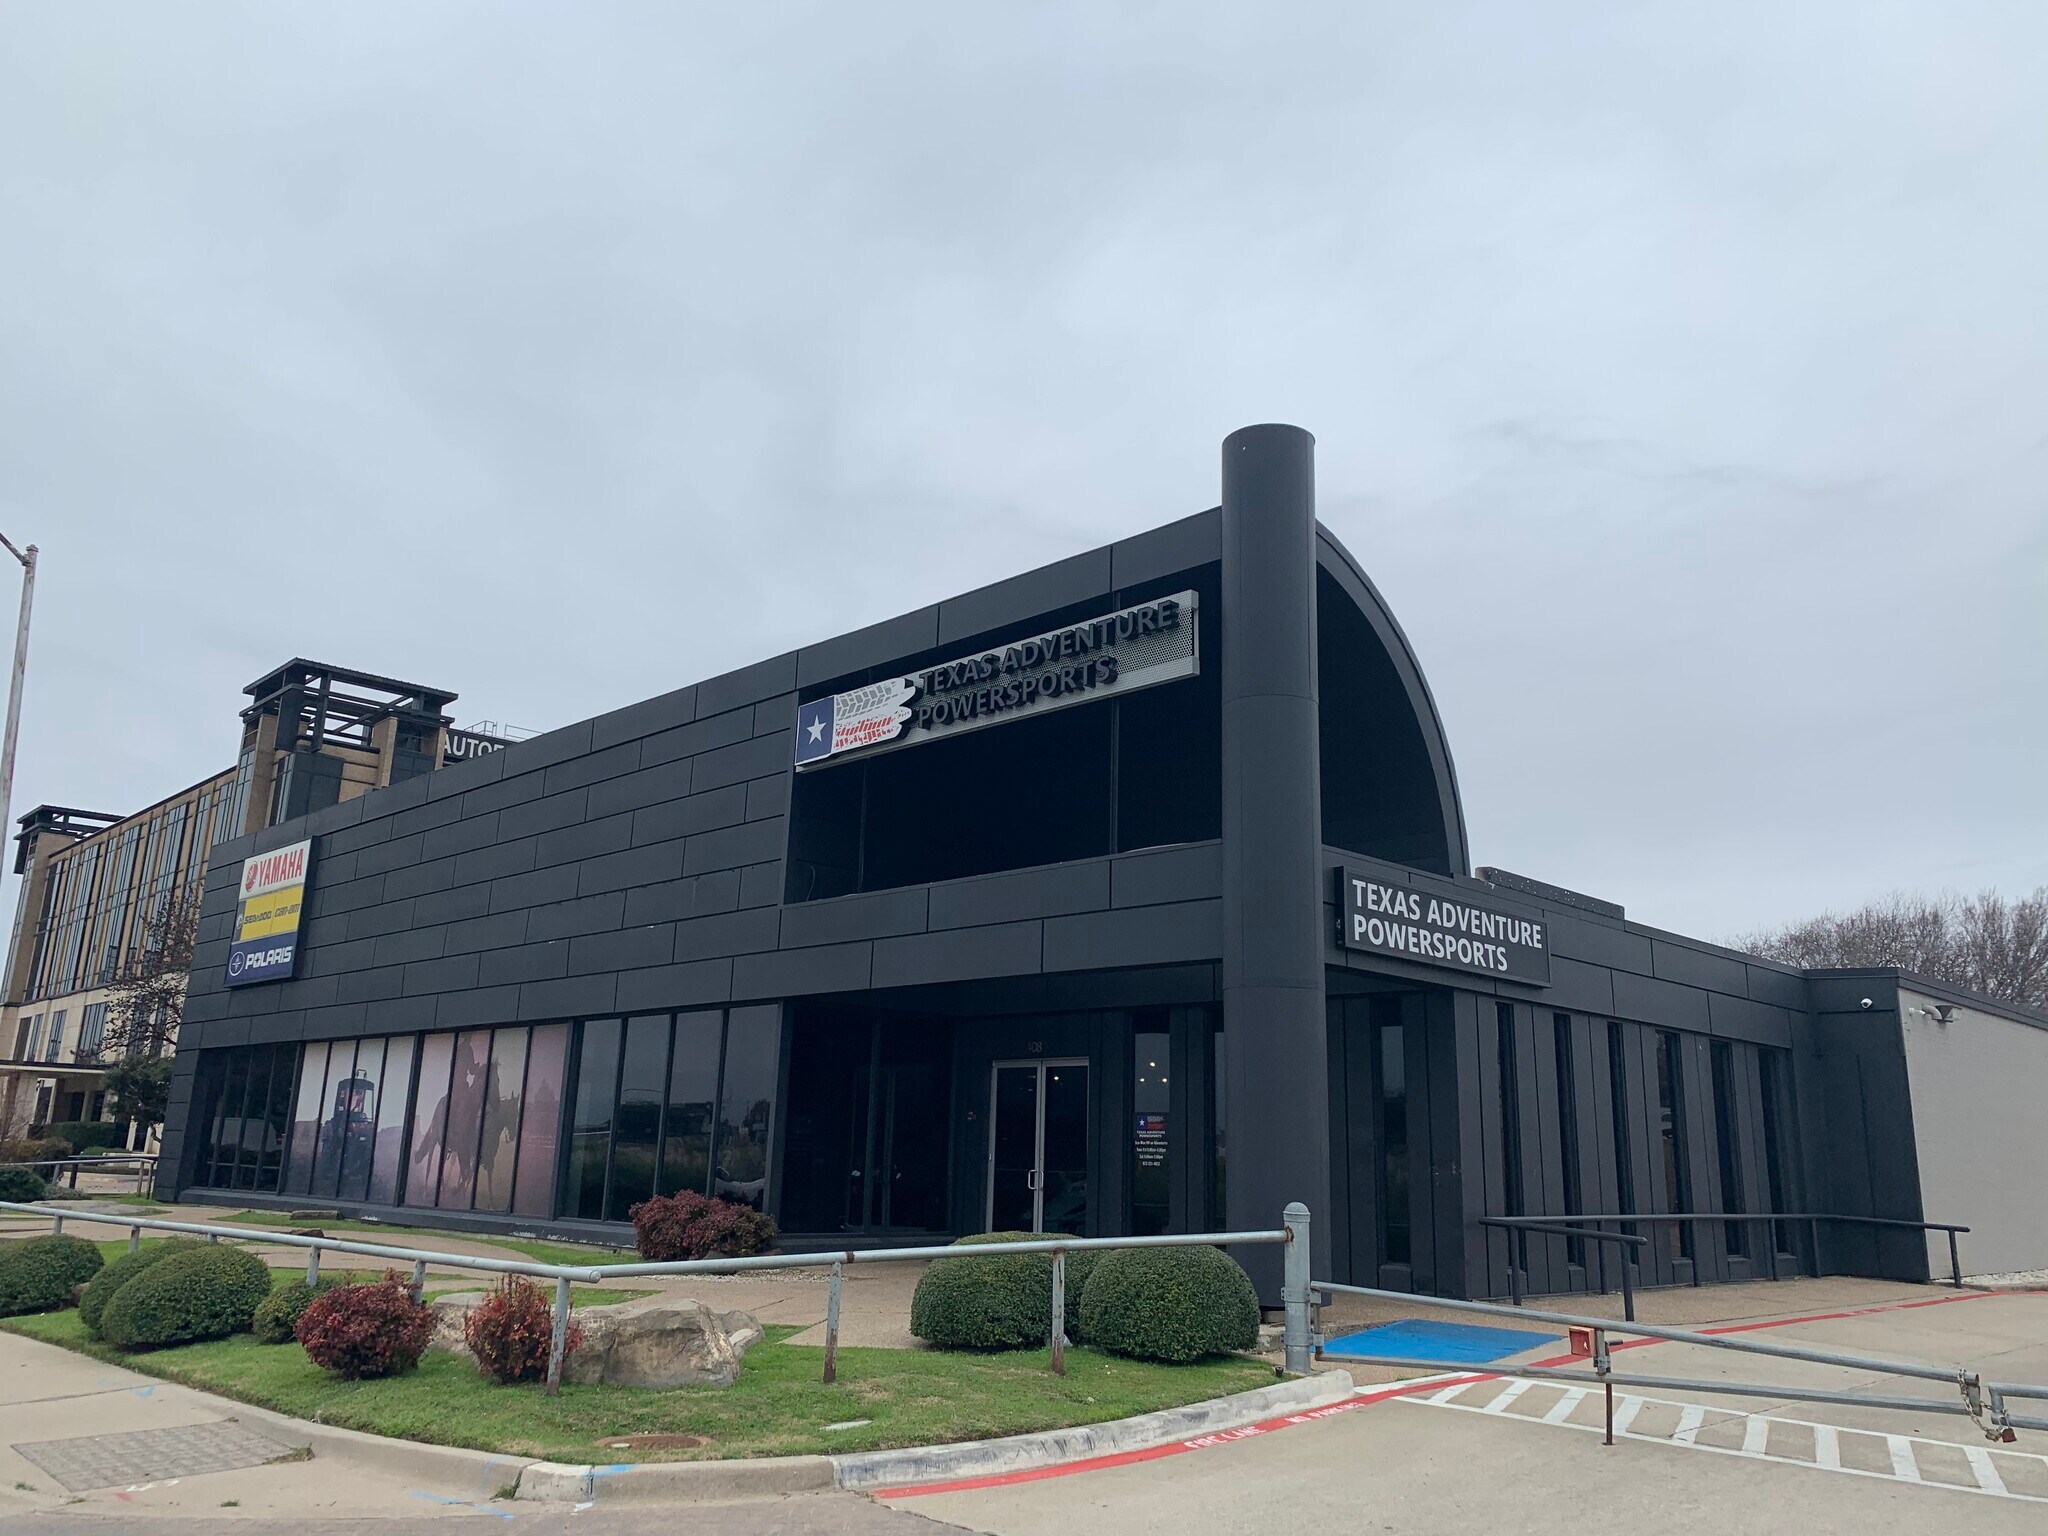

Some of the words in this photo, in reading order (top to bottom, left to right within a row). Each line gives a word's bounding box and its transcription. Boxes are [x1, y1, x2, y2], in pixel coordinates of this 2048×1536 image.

[919, 653, 999, 696] TEXAS
[1002, 600, 1179, 674] ADVENTURE
[918, 656, 1118, 730] POWERSPORTS
[257, 848, 304, 887] YAMAHA
[1352, 879, 1420, 921] TEXAS
[1427, 899, 1544, 950] ADVENTURE
[1353, 914, 1508, 973] POWERSPORTS
[245, 946, 293, 970] POLARIS
[1184, 1435, 1227, 1449] FIRE
[1221, 1426, 1266, 1441] LANE
